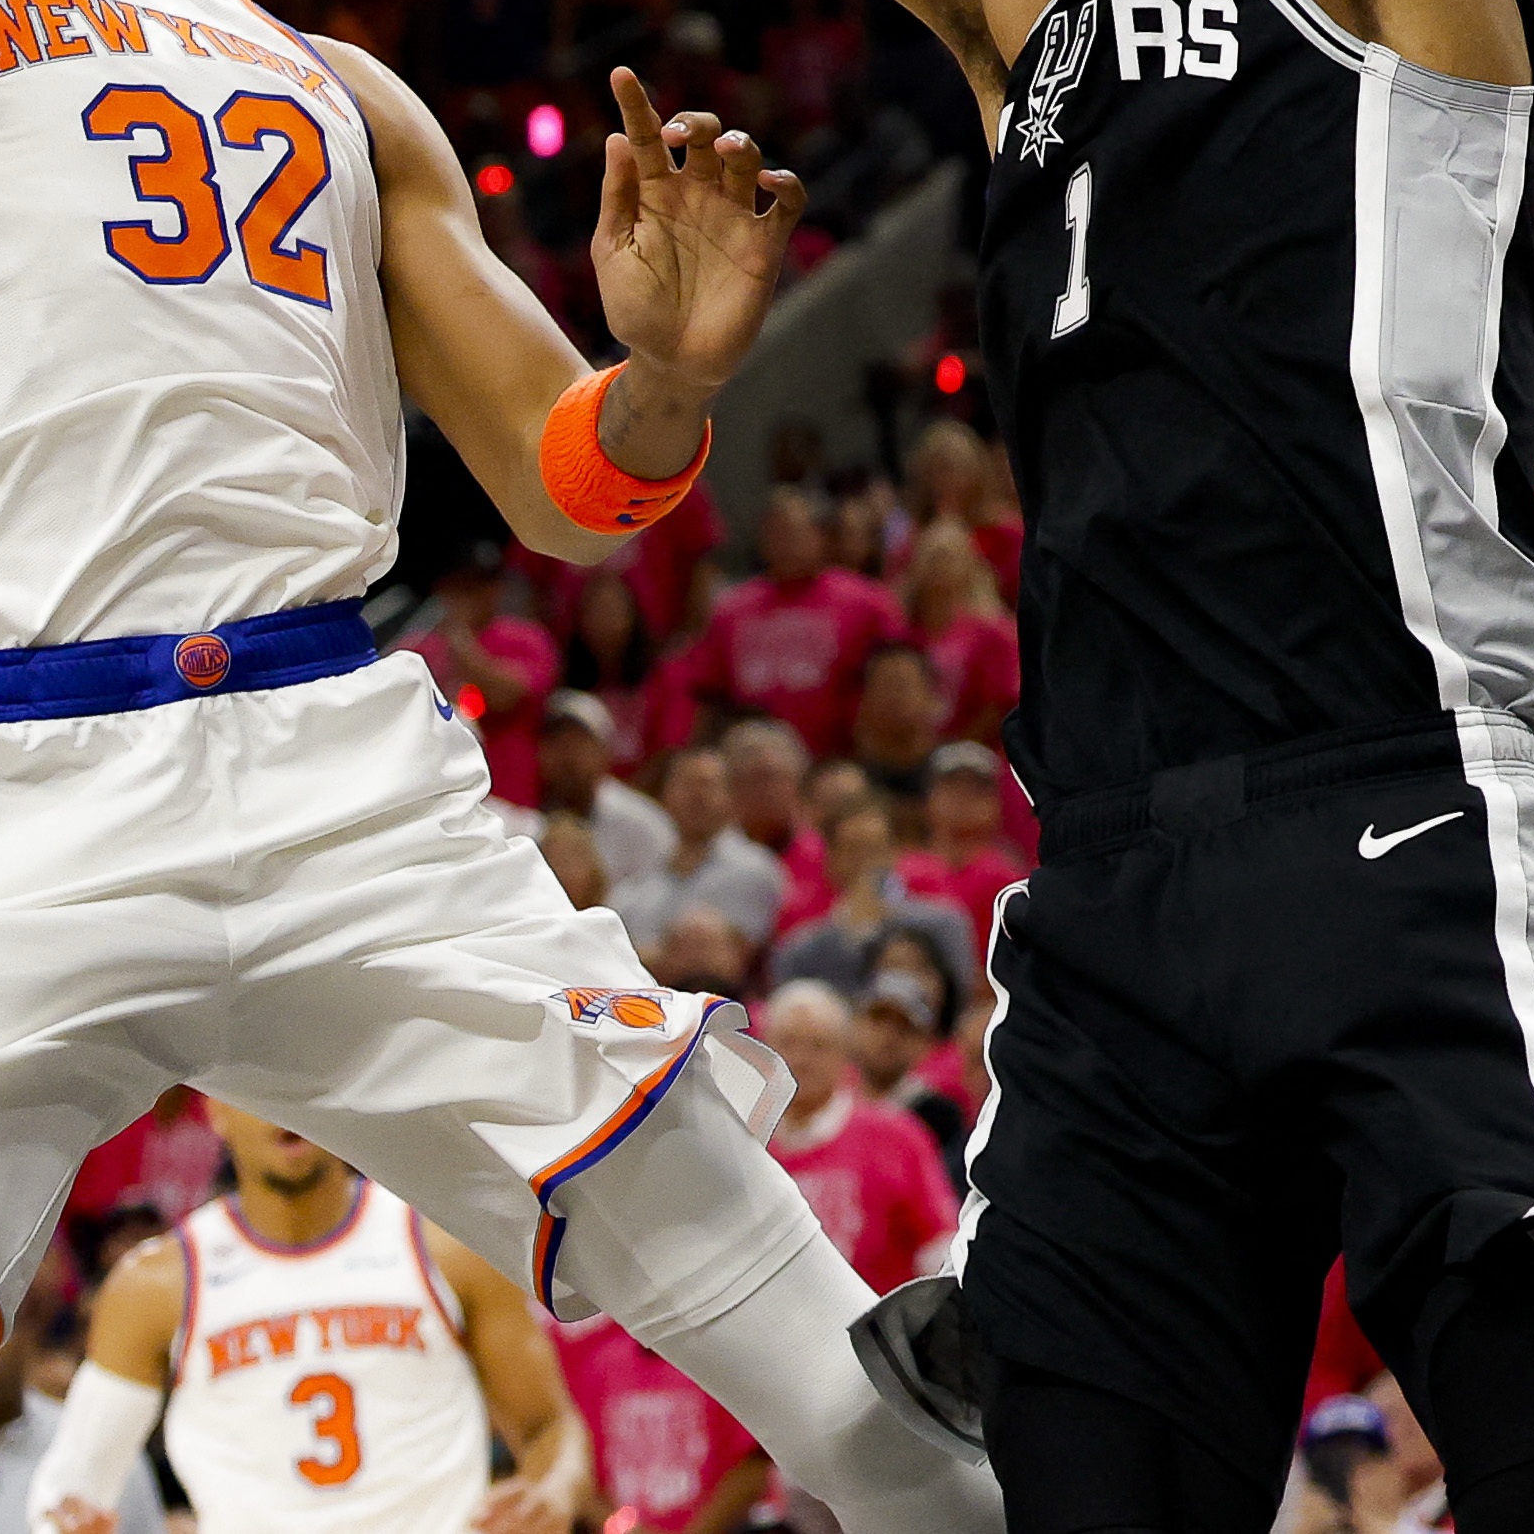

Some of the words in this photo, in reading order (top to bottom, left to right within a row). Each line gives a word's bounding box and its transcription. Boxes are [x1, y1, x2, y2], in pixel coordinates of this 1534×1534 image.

[82, 83, 332, 311] 32
[1051, 162, 1098, 340] 1
[206, 1313, 300, 1378] NEW
[312, 1306, 424, 1352] YORK
[291, 1372, 360, 1487] 3
